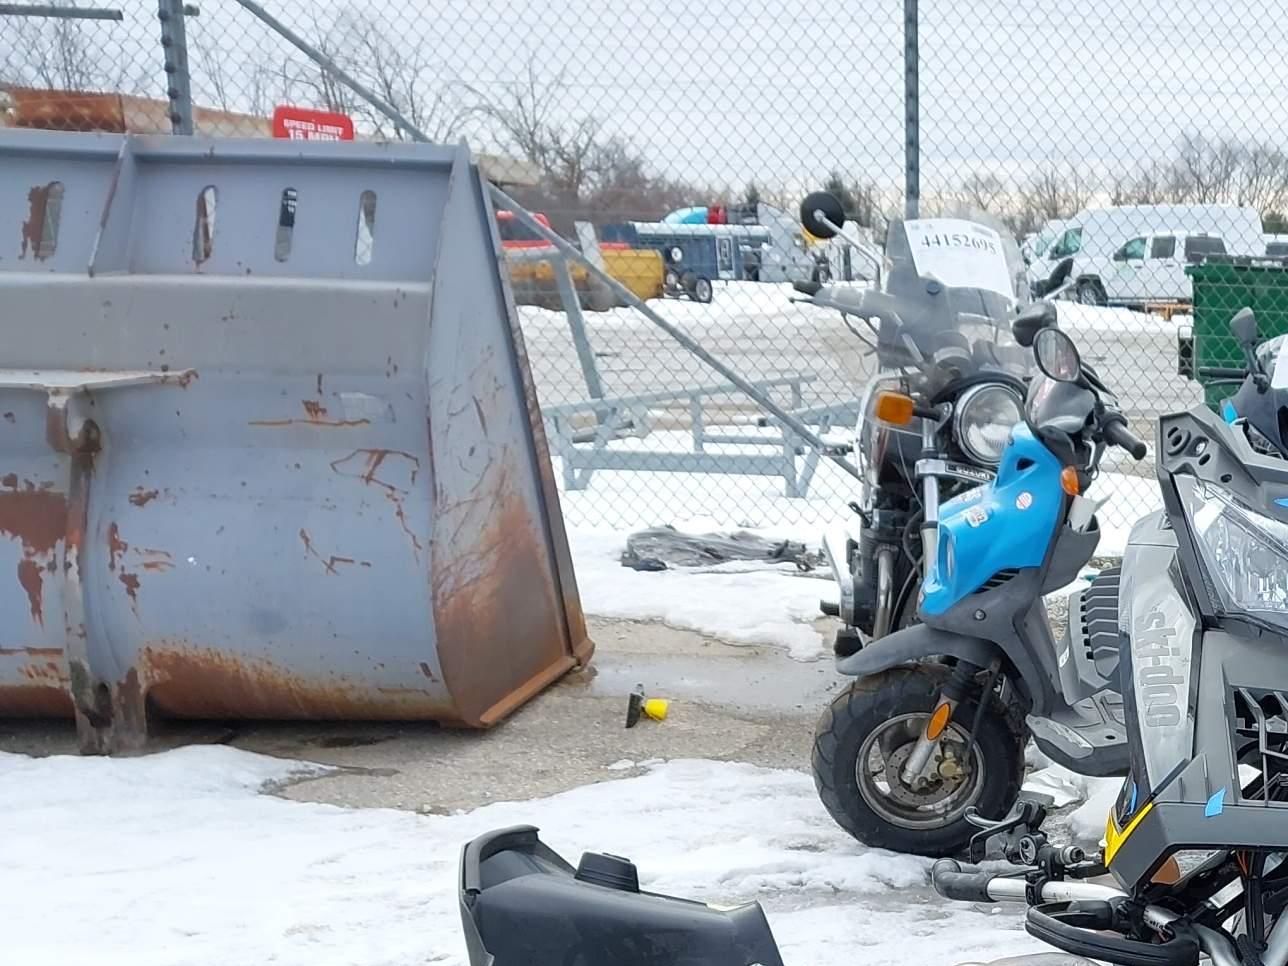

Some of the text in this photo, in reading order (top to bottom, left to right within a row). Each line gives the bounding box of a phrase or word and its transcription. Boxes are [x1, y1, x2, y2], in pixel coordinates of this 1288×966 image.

[283, 118, 344, 138] SPEED LIMIT
[921, 233, 998, 256] 44152695
[1134, 611, 1185, 728] ski-doo
